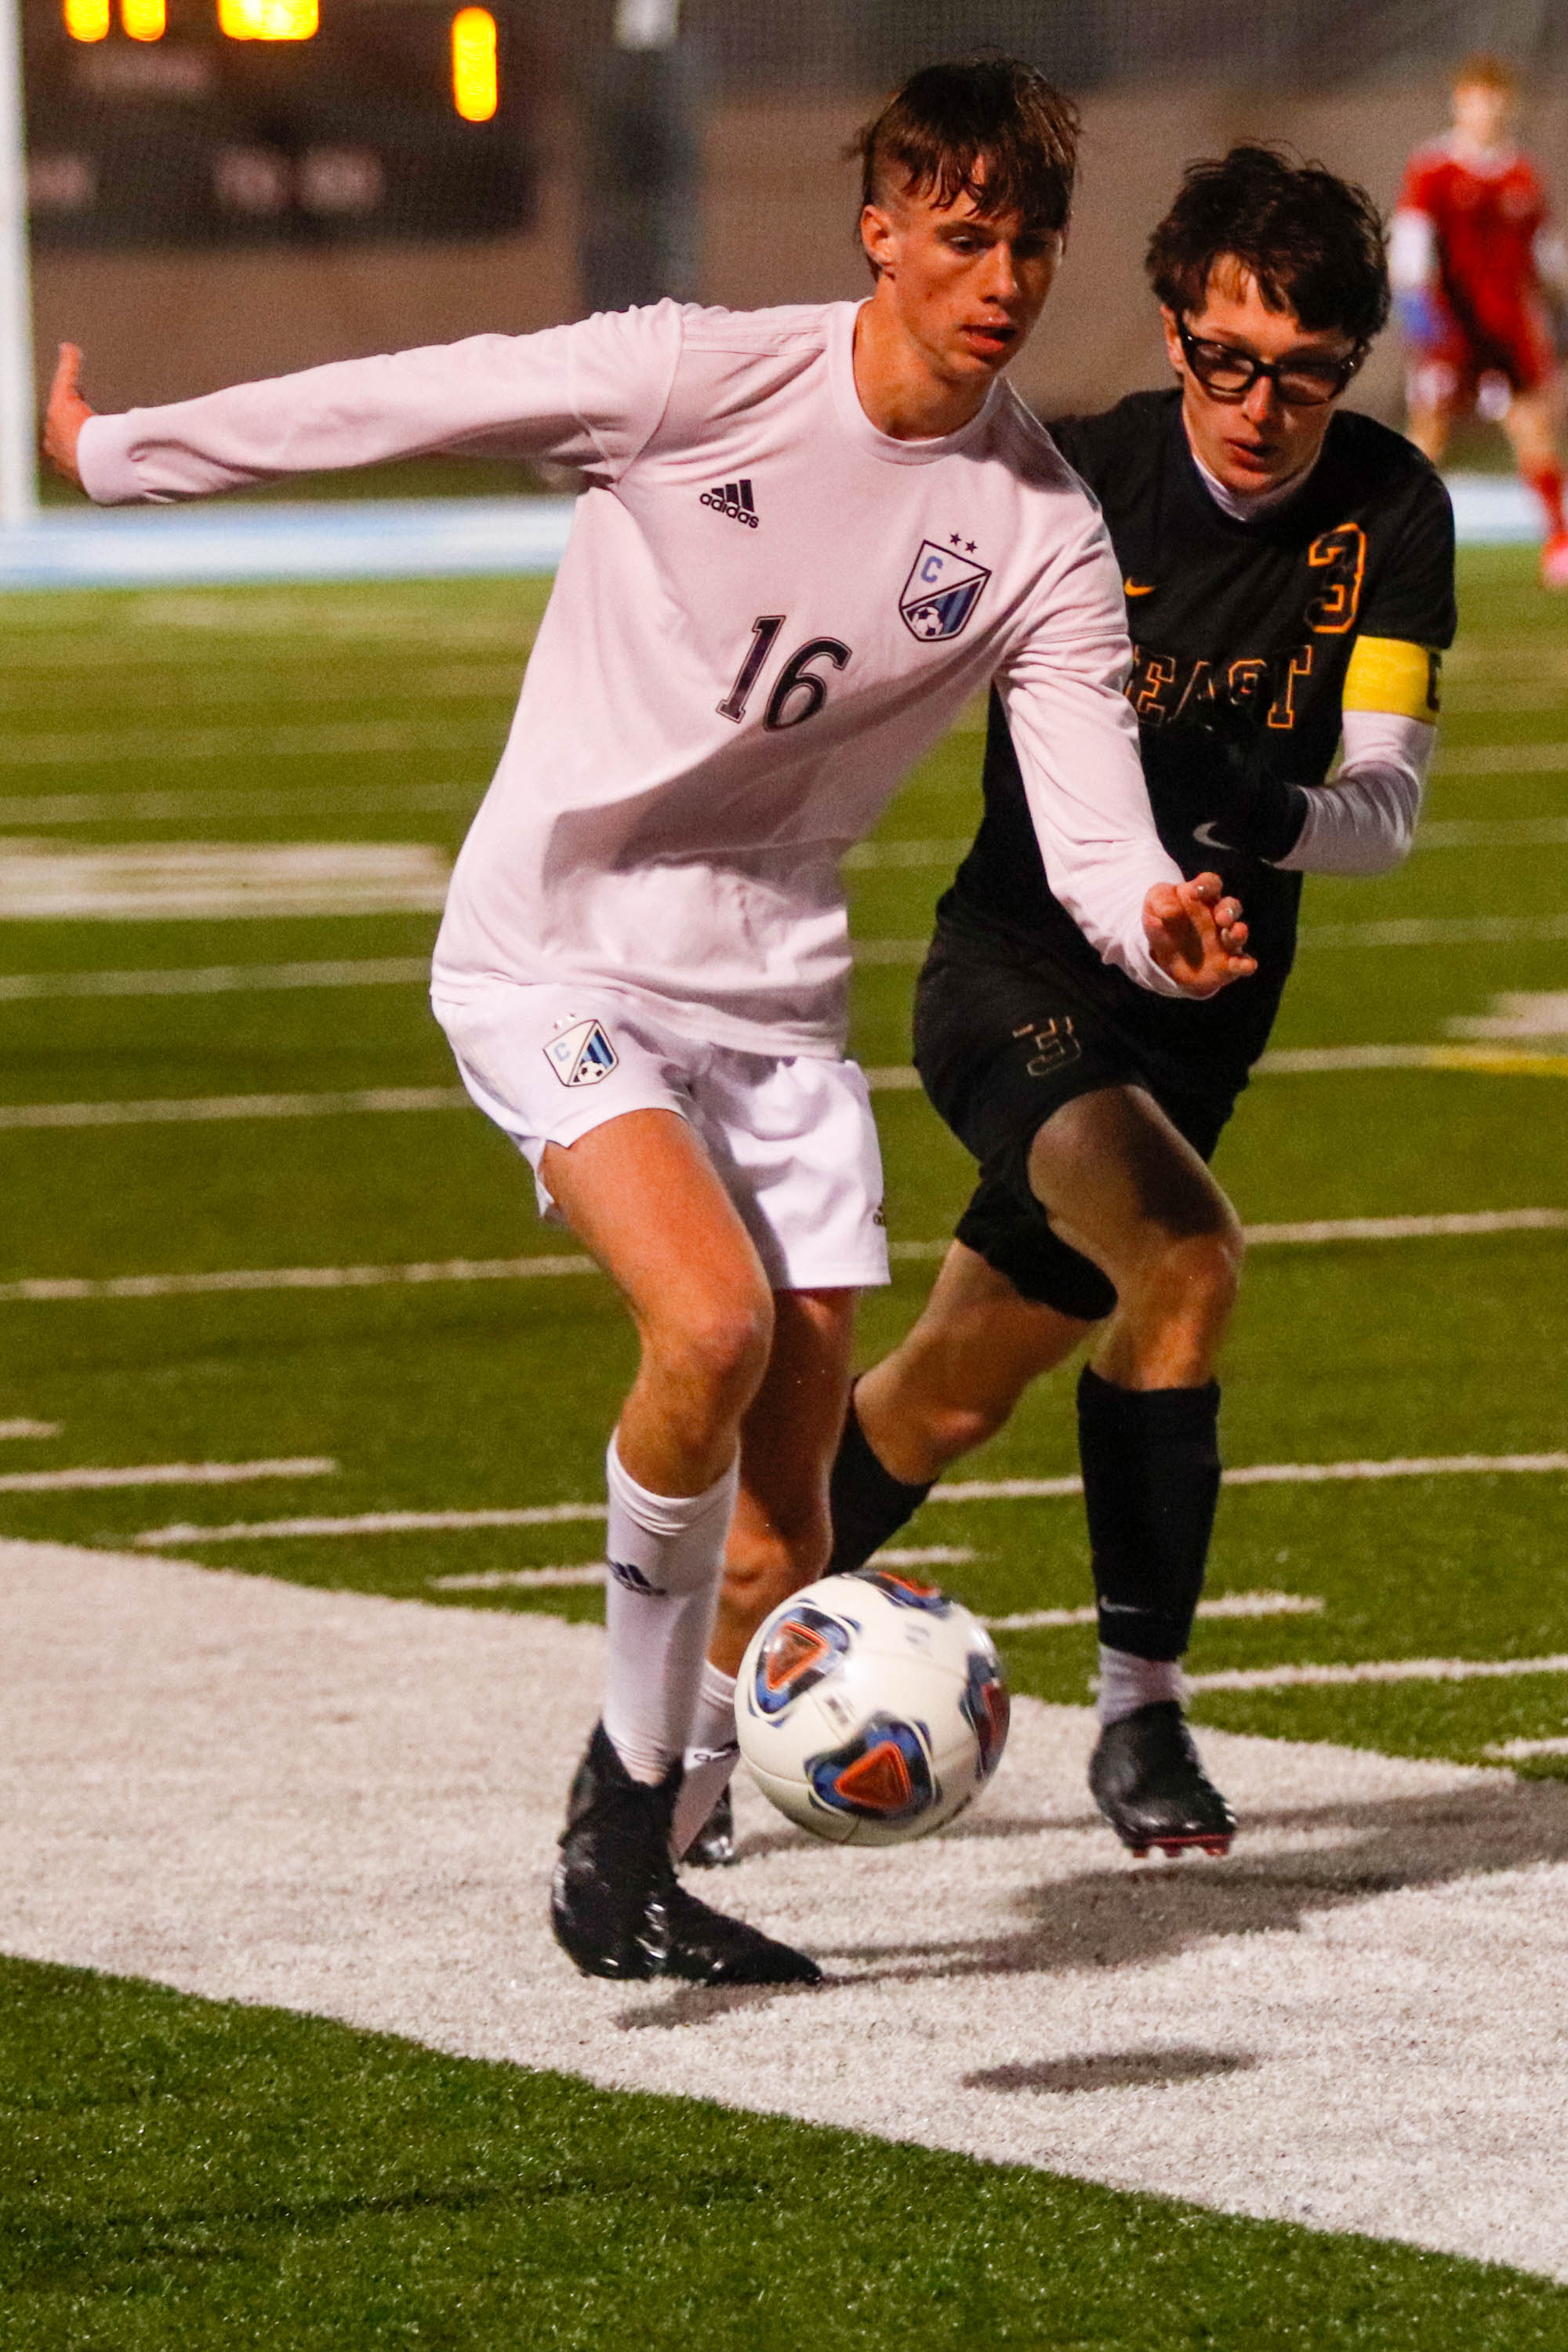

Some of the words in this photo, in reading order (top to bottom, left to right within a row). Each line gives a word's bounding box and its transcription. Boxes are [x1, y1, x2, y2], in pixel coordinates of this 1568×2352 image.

[700, 493, 759, 528] adidas
[921, 556, 943, 583] C
[1304, 522, 1367, 633] 3
[716, 615, 853, 732] 16
